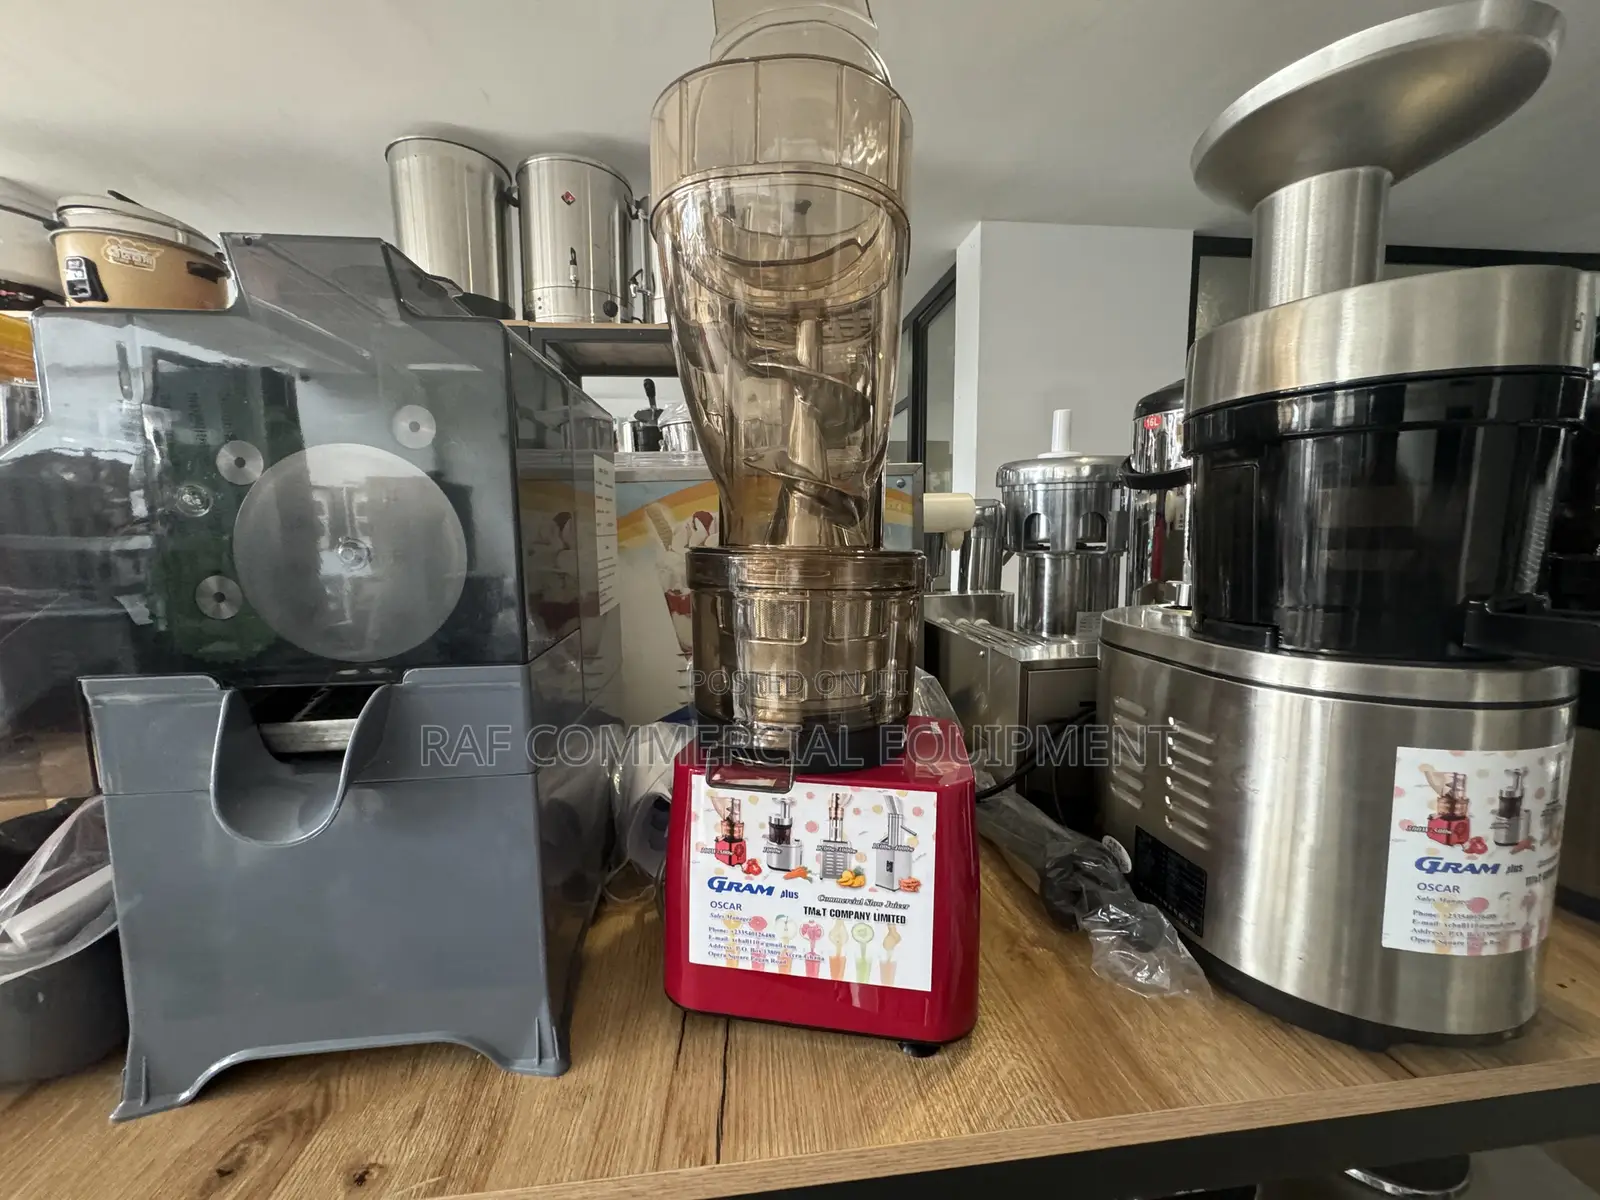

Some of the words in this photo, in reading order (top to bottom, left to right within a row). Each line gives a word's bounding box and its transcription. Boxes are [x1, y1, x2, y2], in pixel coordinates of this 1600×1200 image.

[1146, 417, 1159, 427] 16L
[1414, 856, 1501, 875] GRAM
[707, 876, 775, 896] GRAM
[780, 889, 799, 899] plus
[1417, 883, 1461, 894] OSCAR
[710, 901, 743, 911] OSCAR
[803, 905, 827, 917] TM&T
[829, 908, 871, 921] COMPANY
[873, 912, 907, 925] LIMITED
